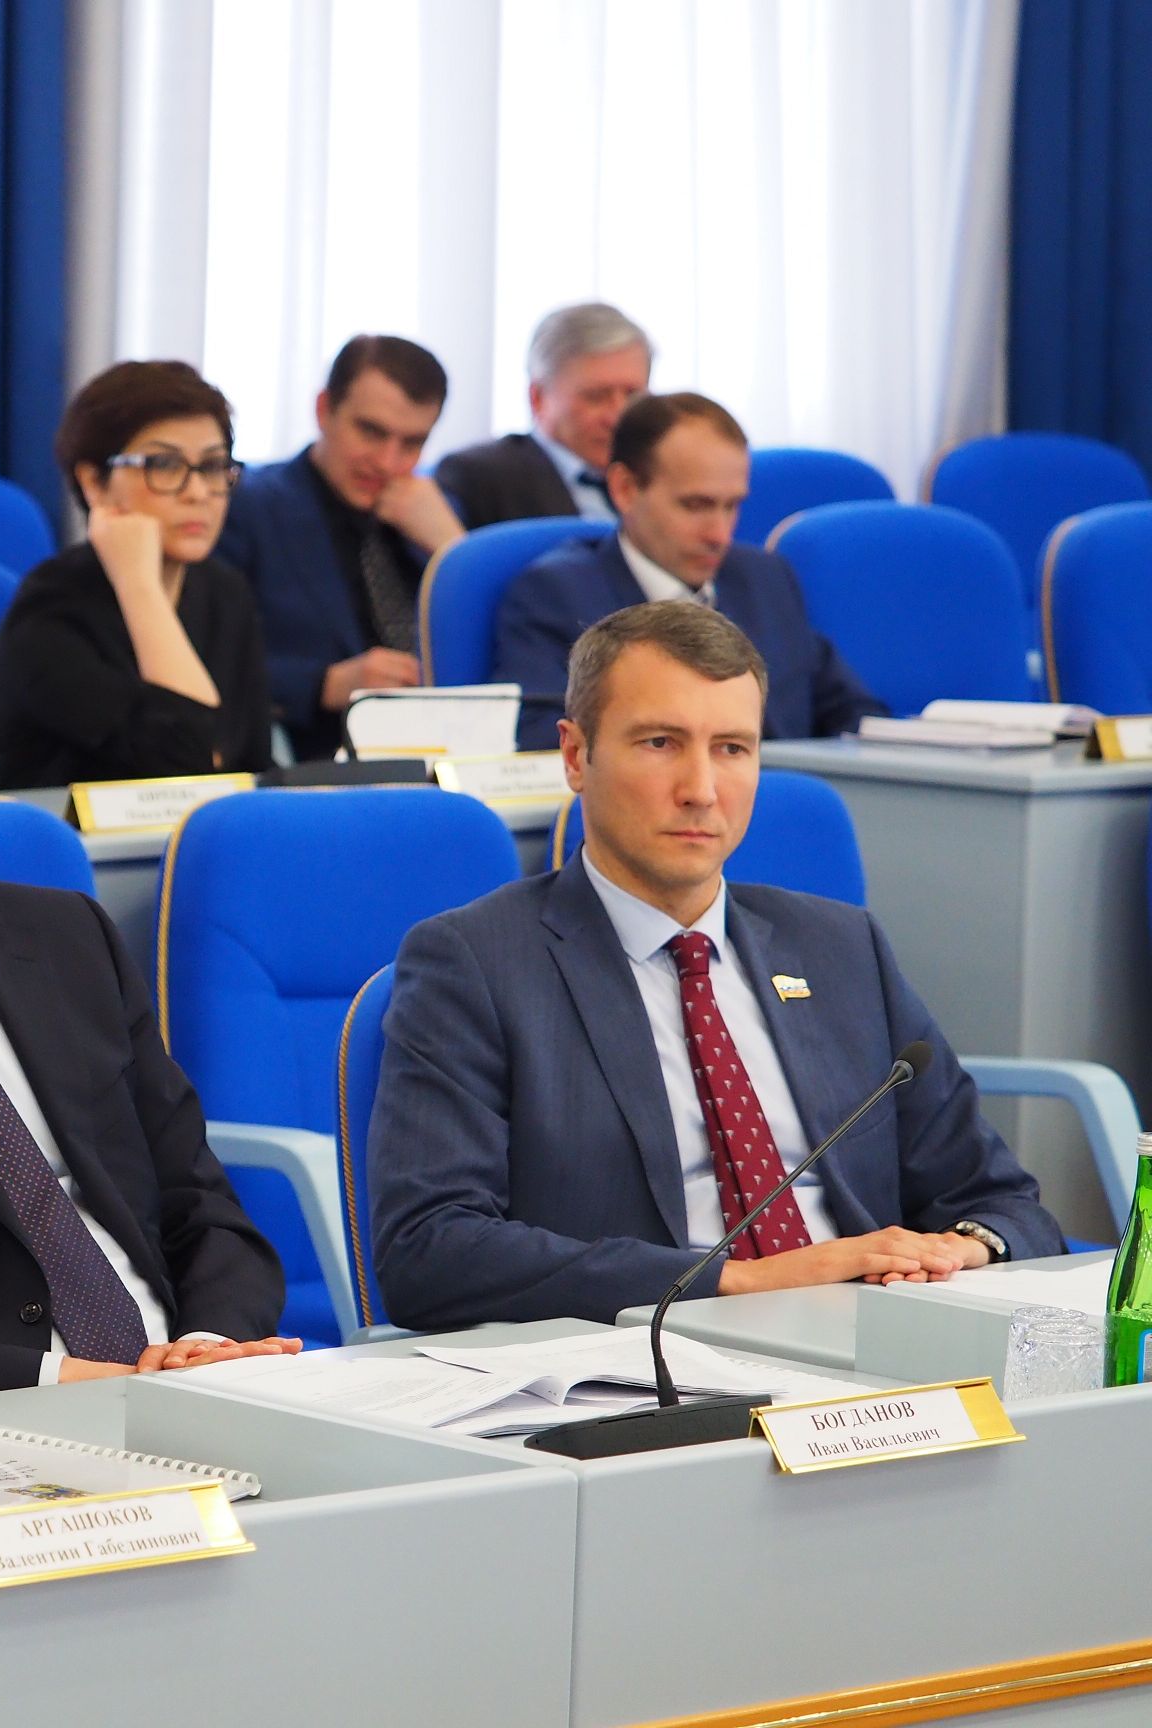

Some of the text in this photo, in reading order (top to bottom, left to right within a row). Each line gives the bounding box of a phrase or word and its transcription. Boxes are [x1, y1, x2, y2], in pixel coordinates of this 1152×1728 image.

[810, 1400, 916, 1431] БОГДАНОВ
[807, 1427, 941, 1458] Иван Васильевич
[19, 1504, 154, 1538] АРГАШОКОВ
[83, 1529, 201, 1557] Габелинович
